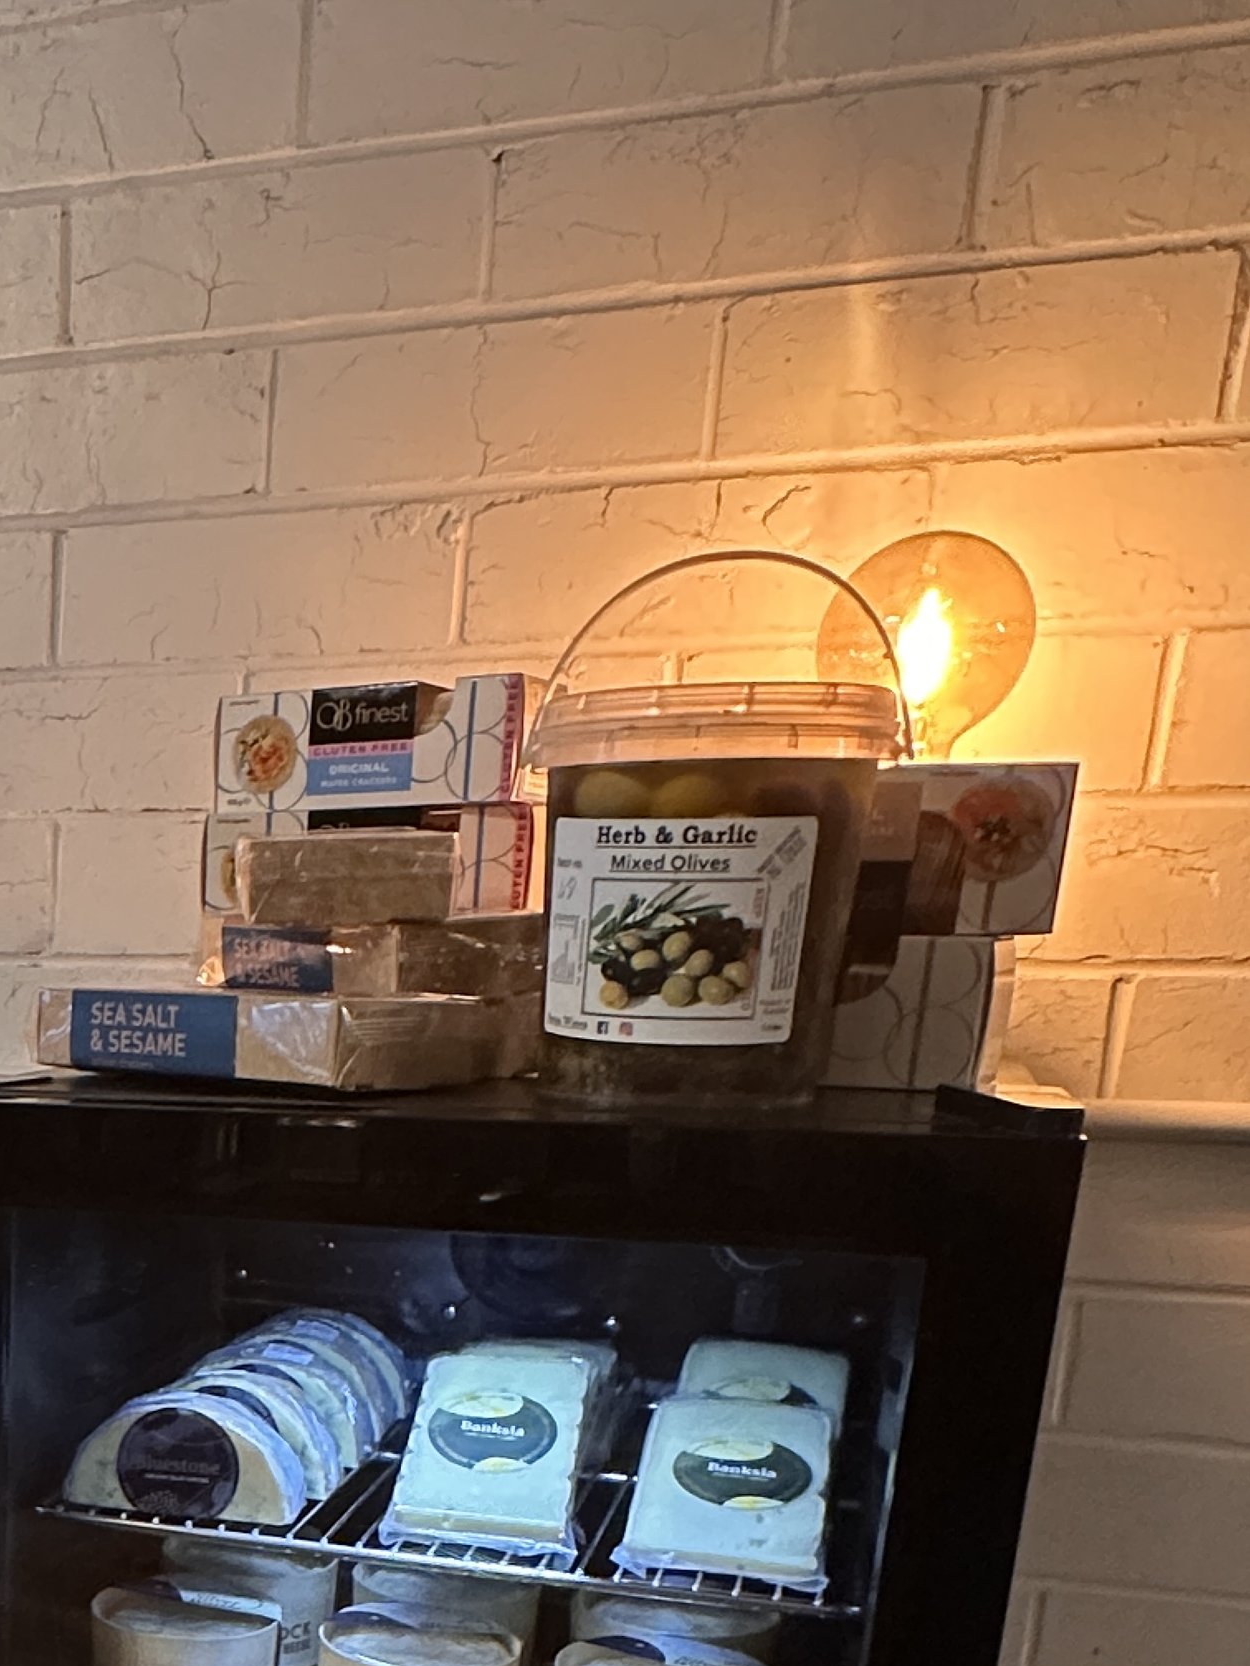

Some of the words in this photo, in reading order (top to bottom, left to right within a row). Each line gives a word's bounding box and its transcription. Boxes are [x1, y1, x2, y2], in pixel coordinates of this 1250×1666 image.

[355, 701, 409, 725] finest
[312, 743, 367, 757] GLUTEN
[370, 740, 408, 753] FREE
[329, 763, 390, 776] ORIGINAL
[597, 825, 647, 844] Herb
[655, 826, 673, 844] &
[682, 825, 758, 844] Garlic
[611, 854, 666, 870] Mixed
[670, 854, 730, 870] Olives
[90, 1001, 127, 1026] SEA
[131, 1003, 180, 1029] SALT
[90, 1029, 103, 1052] &
[108, 1030, 187, 1058] SESAME
